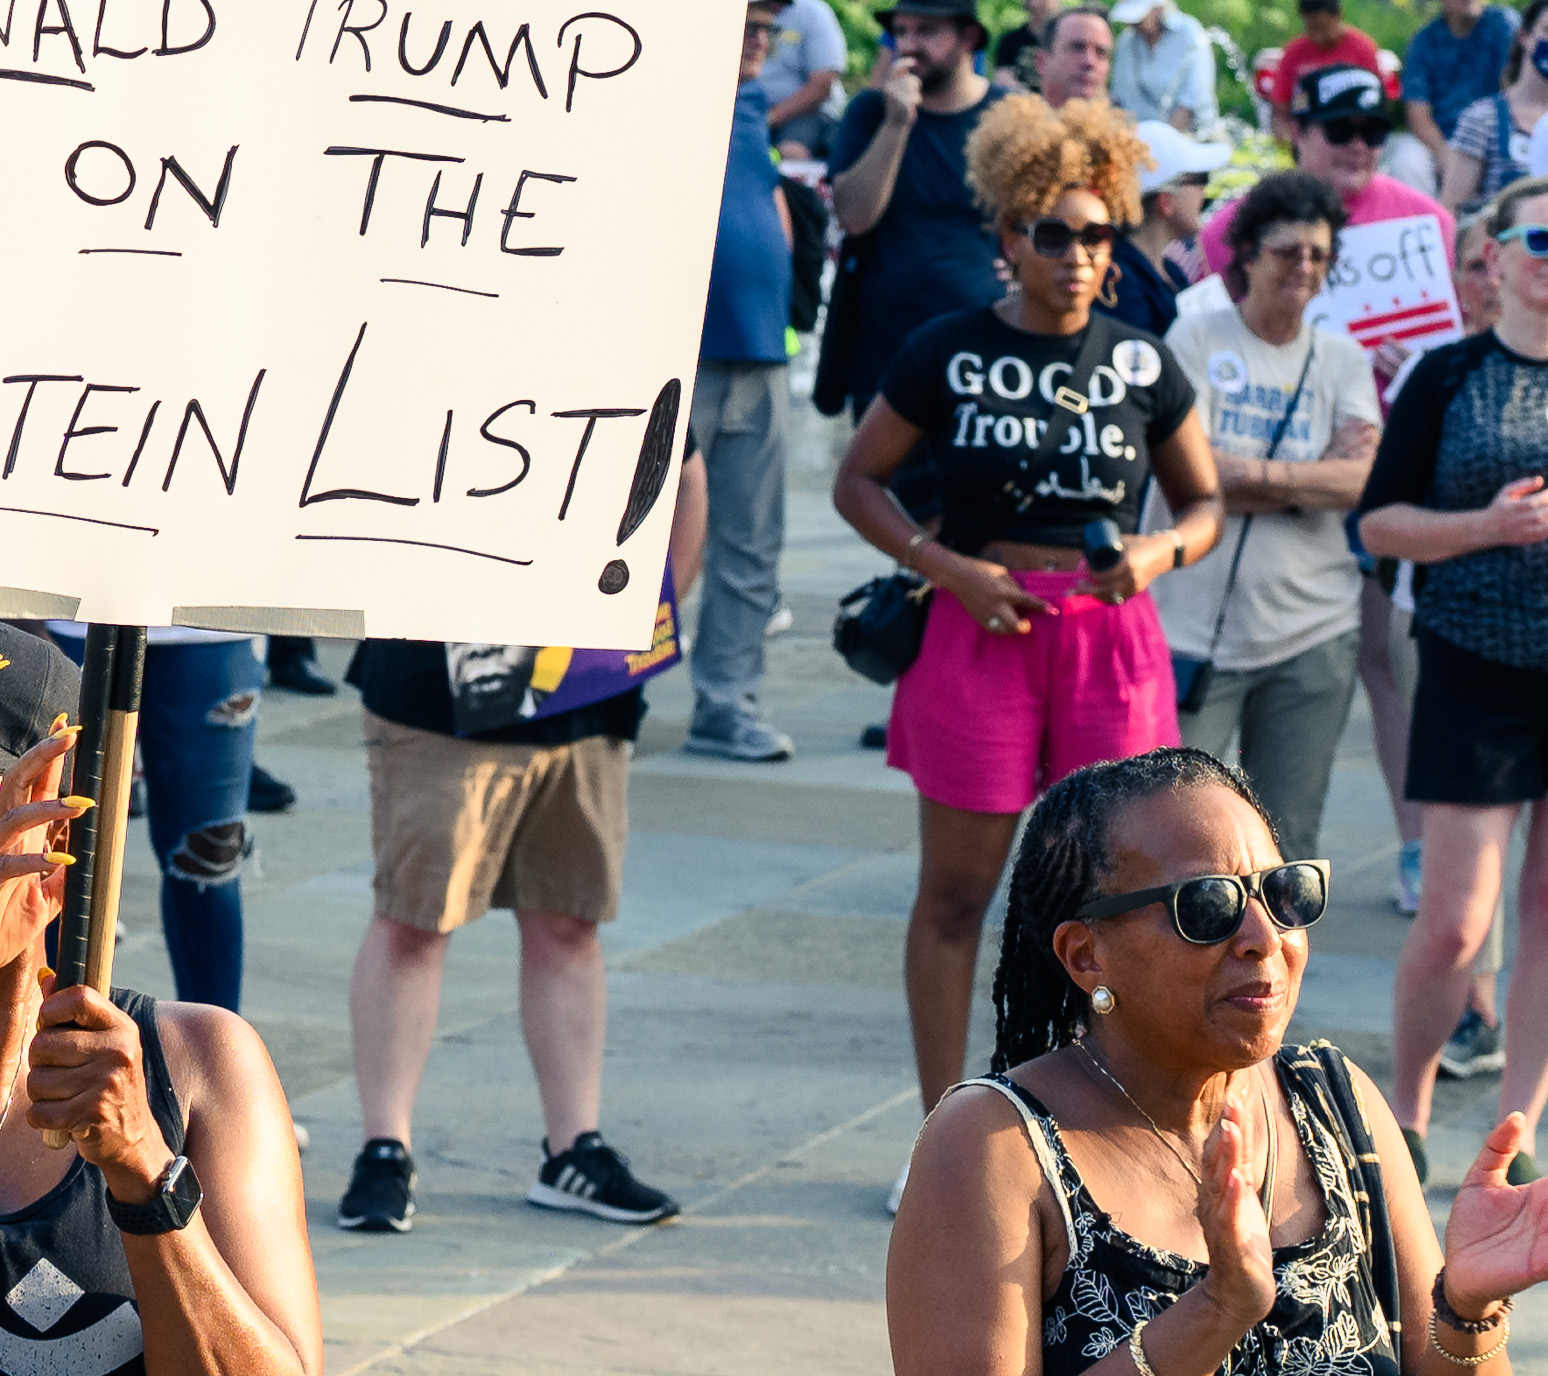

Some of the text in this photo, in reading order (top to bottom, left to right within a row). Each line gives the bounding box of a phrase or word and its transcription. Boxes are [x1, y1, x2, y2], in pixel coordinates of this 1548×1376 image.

[64, 141, 240, 231] ON
[323, 146, 578, 257] THE
[298, 320, 683, 596] LIST!
